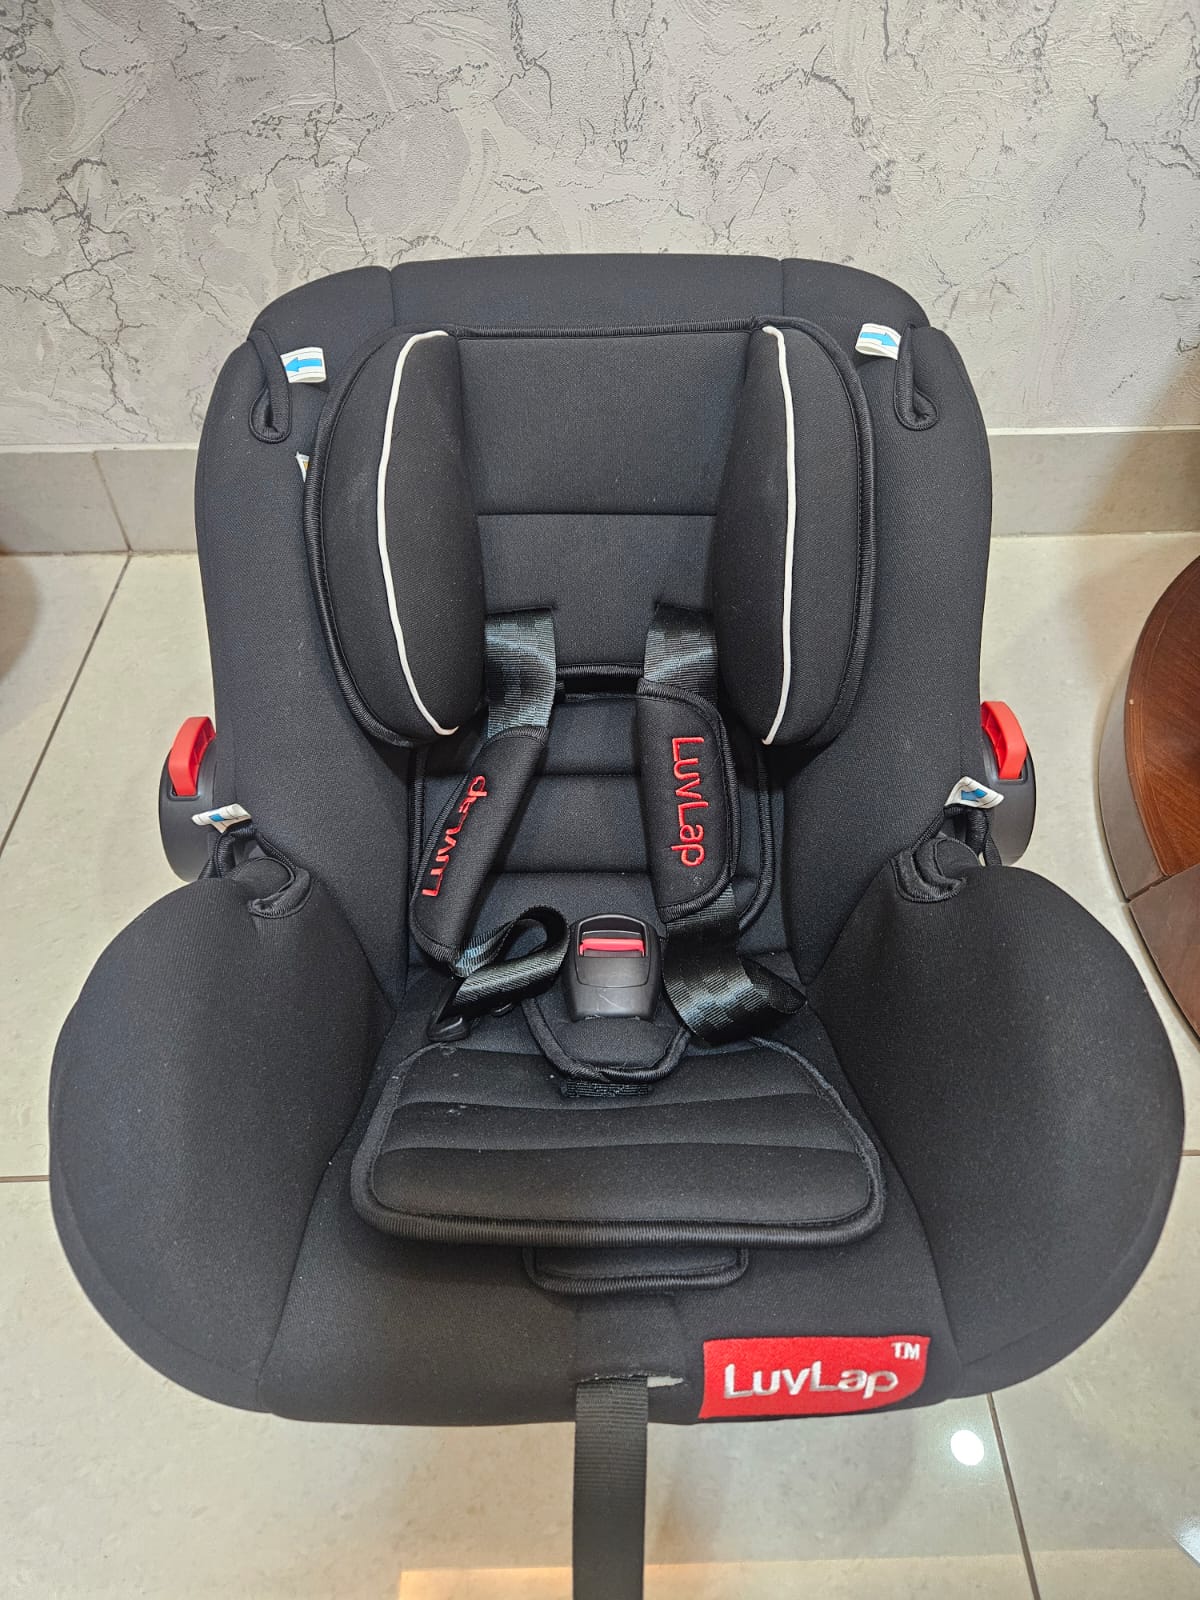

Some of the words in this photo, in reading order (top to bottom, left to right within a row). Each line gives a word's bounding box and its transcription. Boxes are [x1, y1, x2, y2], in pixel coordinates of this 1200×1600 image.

[671, 737, 709, 867] LuvLap
[724, 1360, 898, 1399] LuvLap
[891, 1342, 920, 1360] TM
